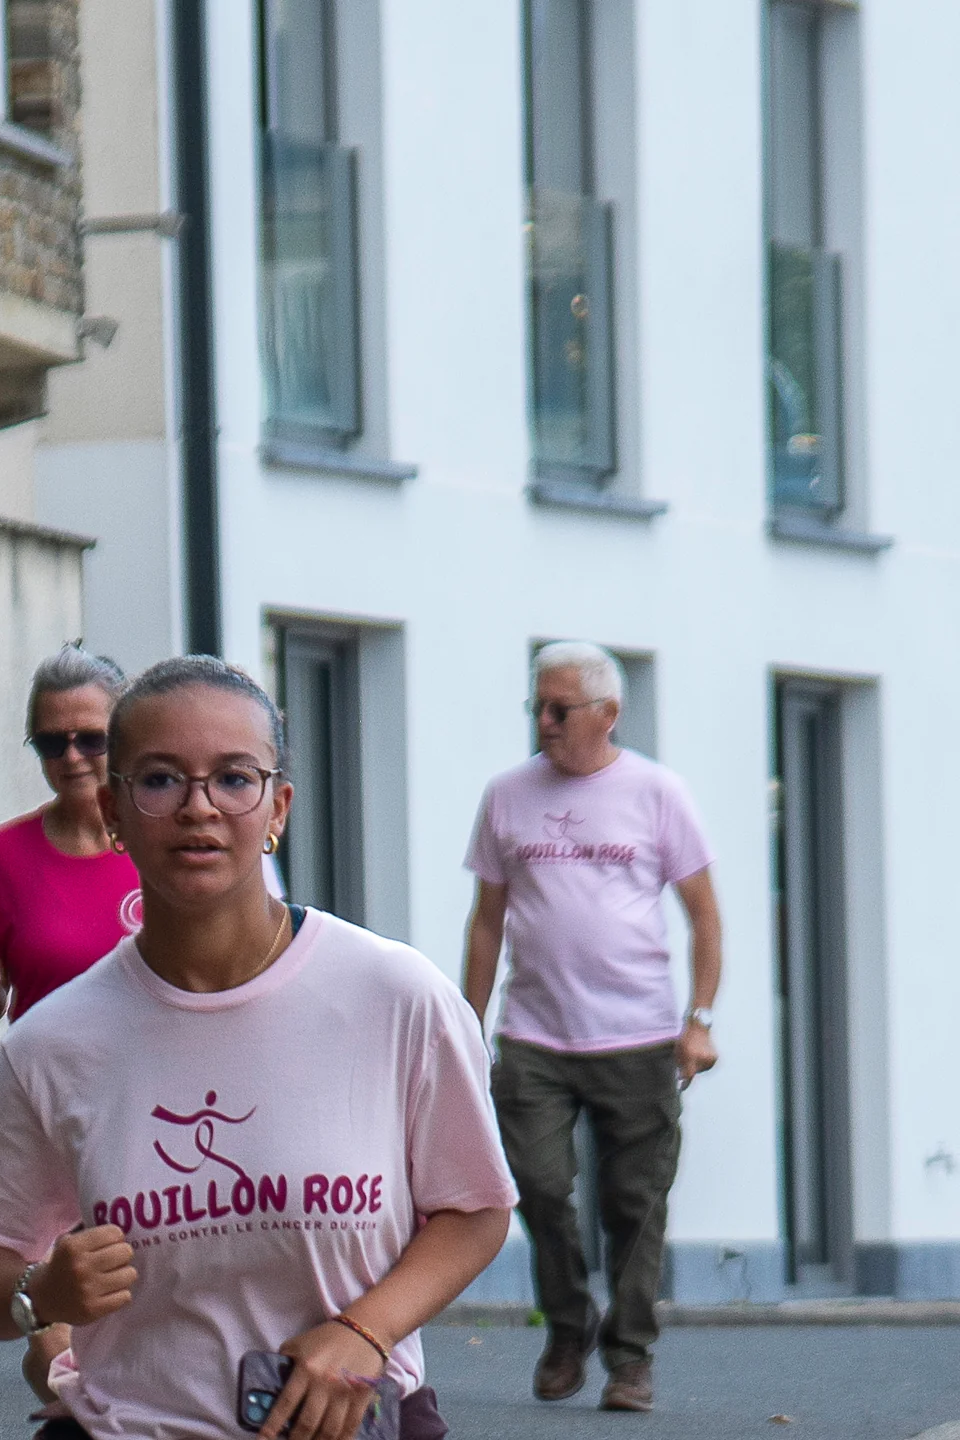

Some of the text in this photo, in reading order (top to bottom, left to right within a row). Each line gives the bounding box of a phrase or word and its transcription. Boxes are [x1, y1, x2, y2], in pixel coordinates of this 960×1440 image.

[599, 843, 636, 862] ROSE
[303, 1173, 382, 1214] ROSE
[168, 1225, 229, 1242] CONTRE
[236, 1223, 253, 1232] LE
[260, 1220, 322, 1231] CANCER
[330, 1221, 348, 1231] DU
